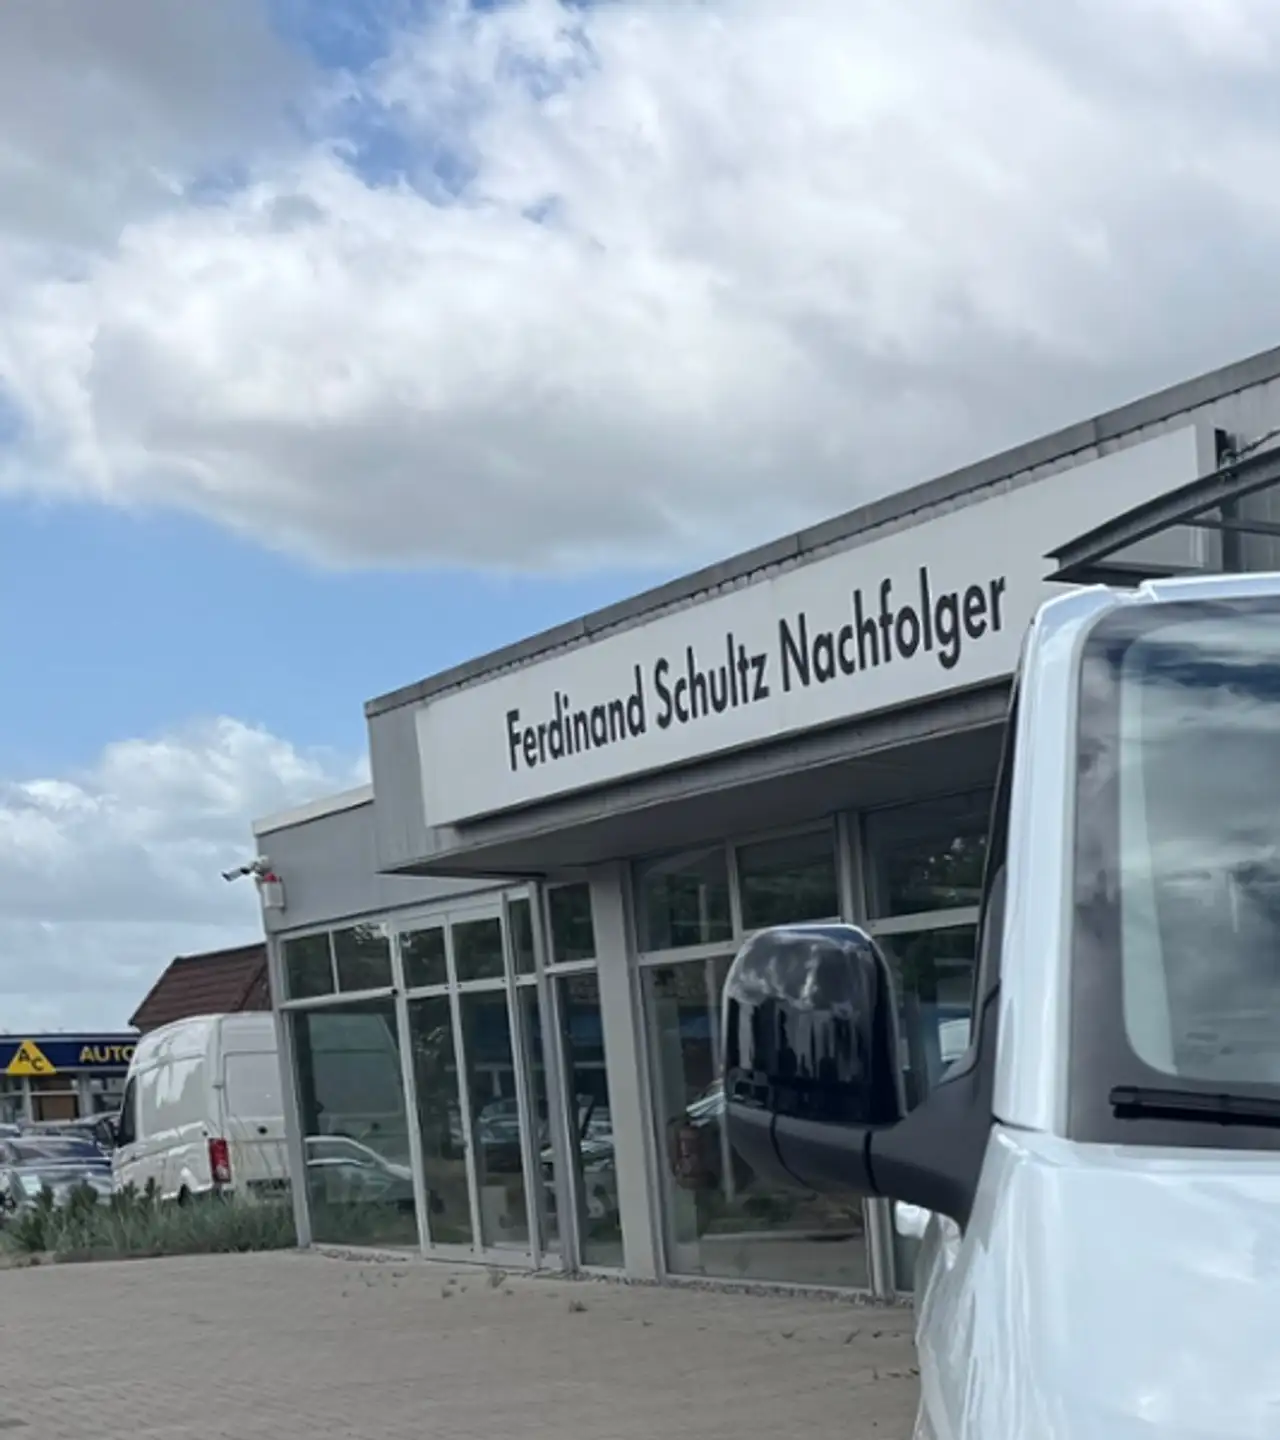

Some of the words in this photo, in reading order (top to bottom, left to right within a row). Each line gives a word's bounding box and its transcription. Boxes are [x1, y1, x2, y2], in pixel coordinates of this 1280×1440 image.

[505, 664, 646, 772] Ferdinand
[653, 632, 770, 729] Schultz
[778, 566, 1005, 692] Nachfolger
